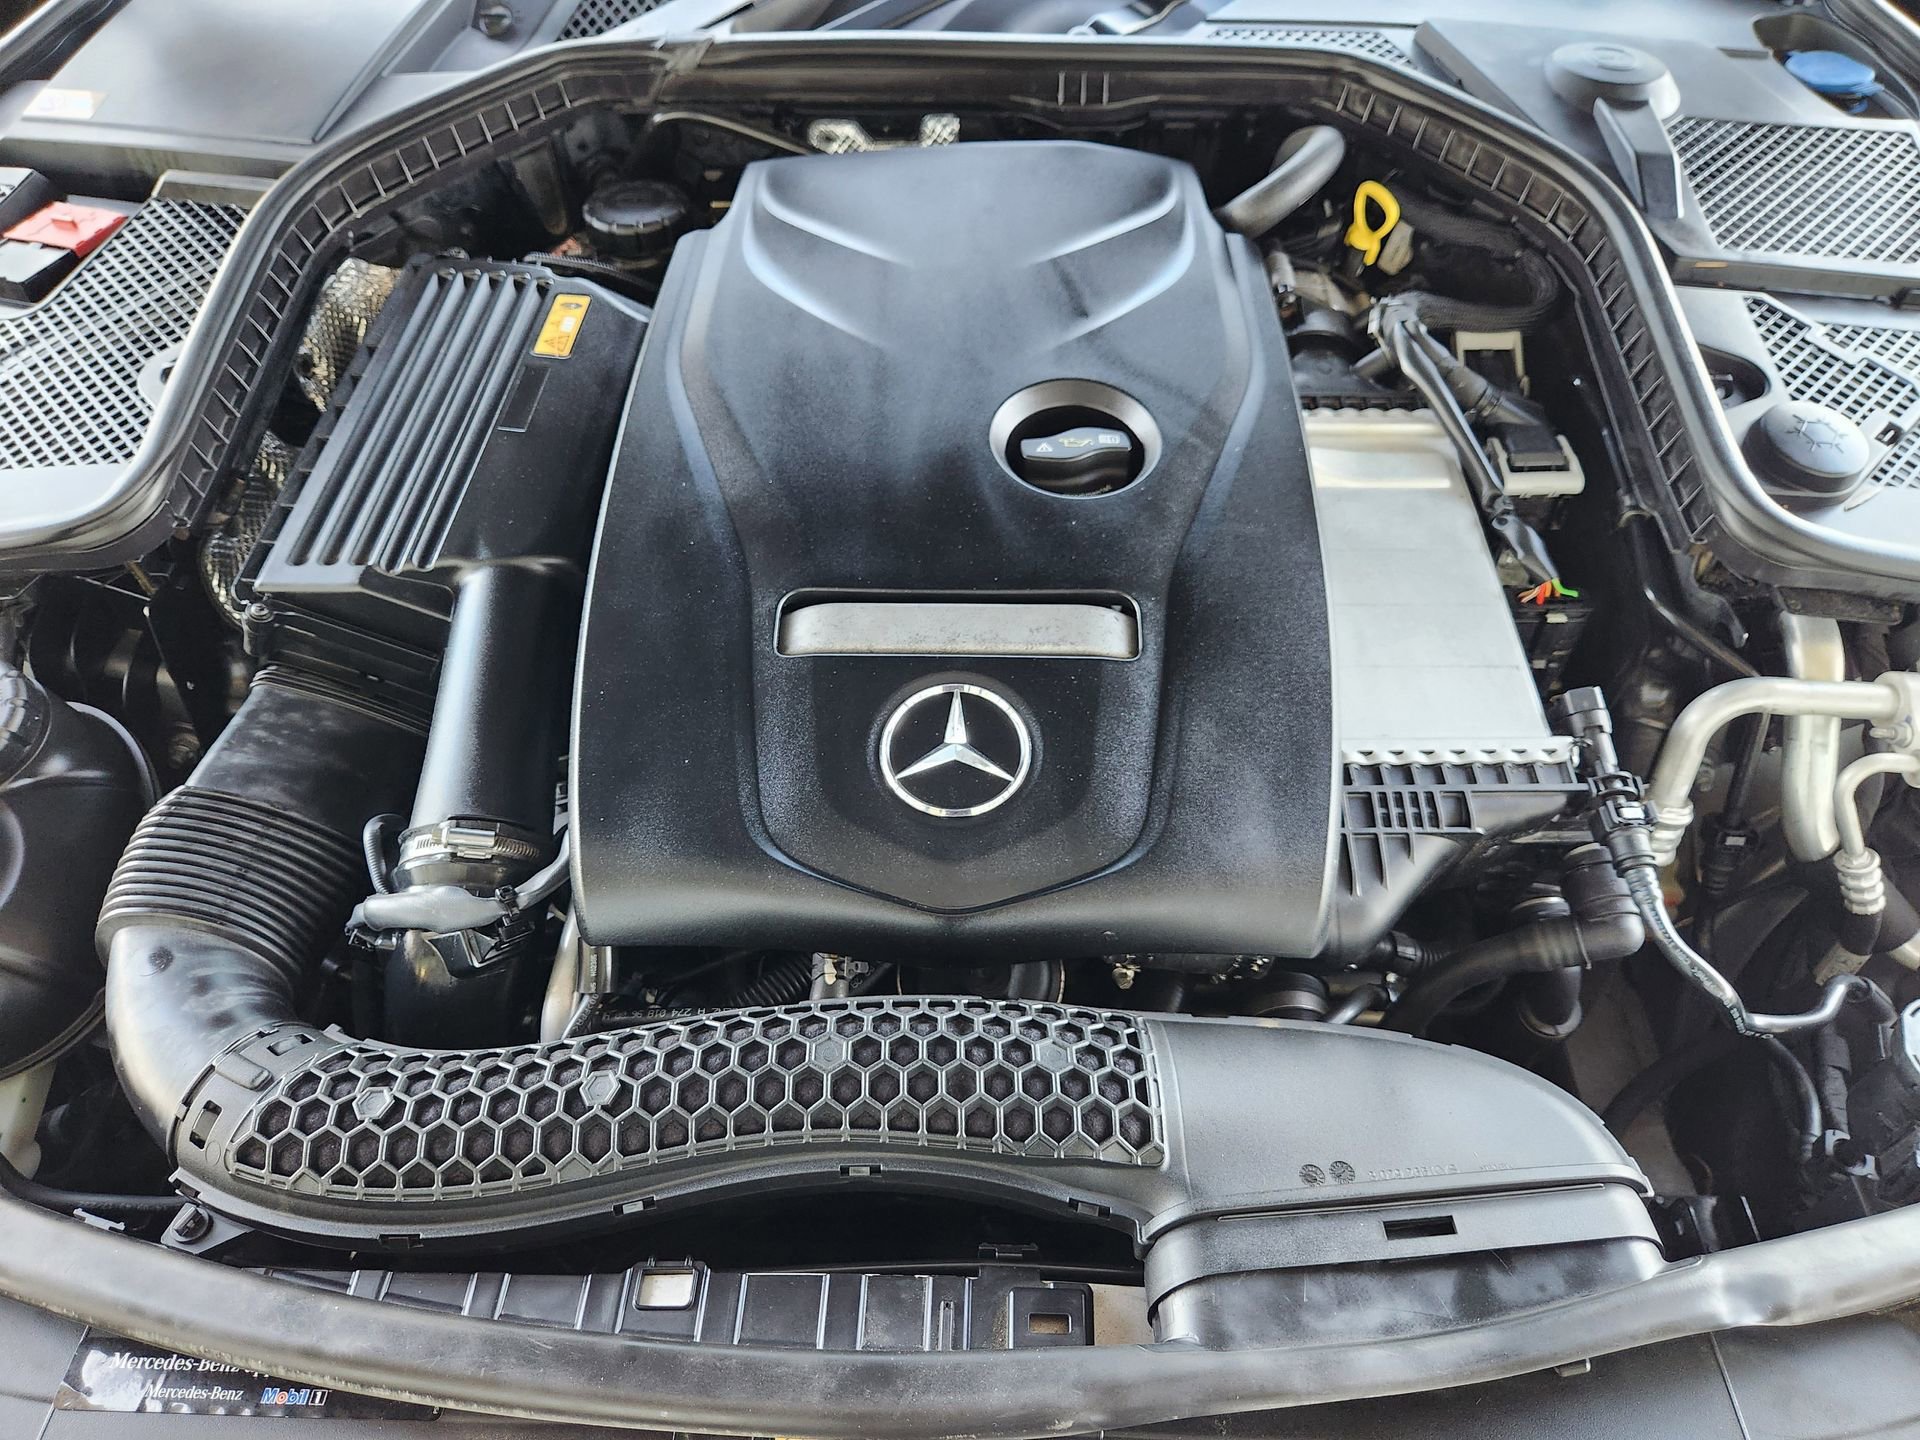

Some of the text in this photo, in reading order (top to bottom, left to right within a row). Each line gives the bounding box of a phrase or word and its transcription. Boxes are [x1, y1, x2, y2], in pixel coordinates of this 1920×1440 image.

[670, 1007, 693, 1018] 274
[108, 1351, 240, 1372] Mercedes-Benz
[145, 1383, 245, 1402] Mercedes-Benz
[260, 1387, 309, 1406] Mobil
